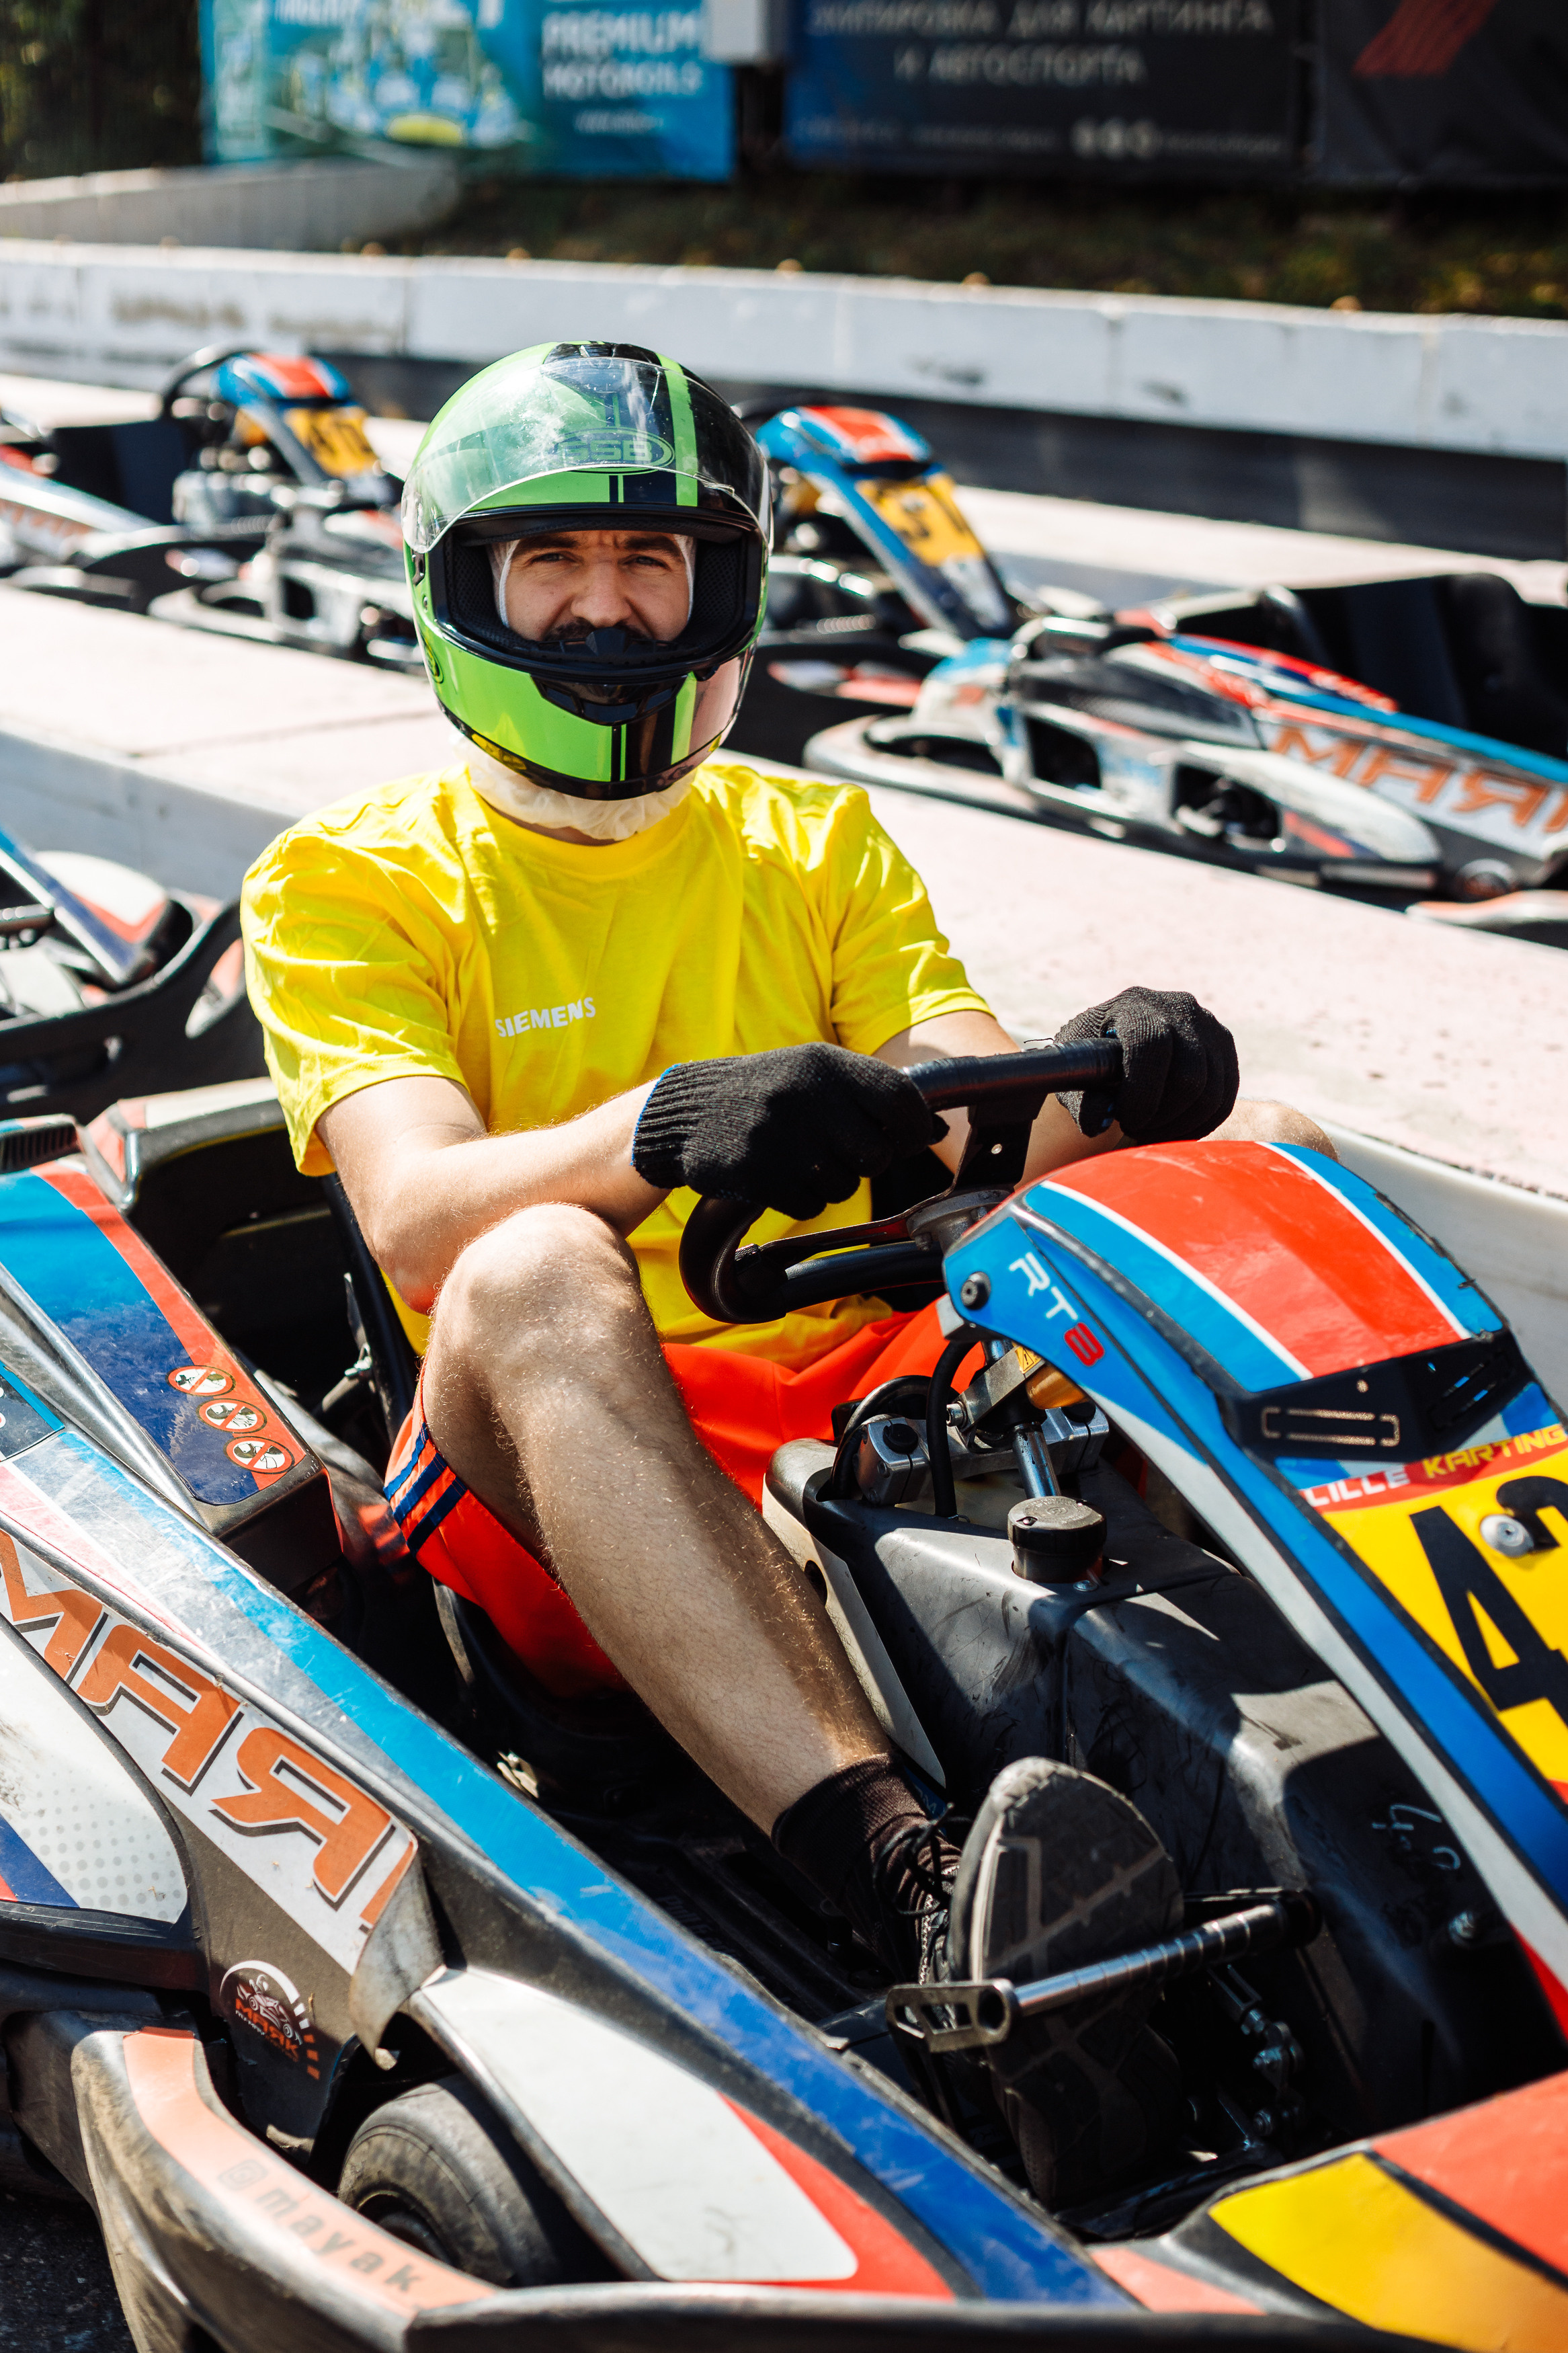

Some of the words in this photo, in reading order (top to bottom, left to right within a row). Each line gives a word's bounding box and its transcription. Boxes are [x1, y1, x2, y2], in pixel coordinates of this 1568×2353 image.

[495, 997, 595, 1037] SIEMENS
[1306, 1465, 1411, 1507] LILLE
[1421, 1423, 1568, 1478] KARTING
